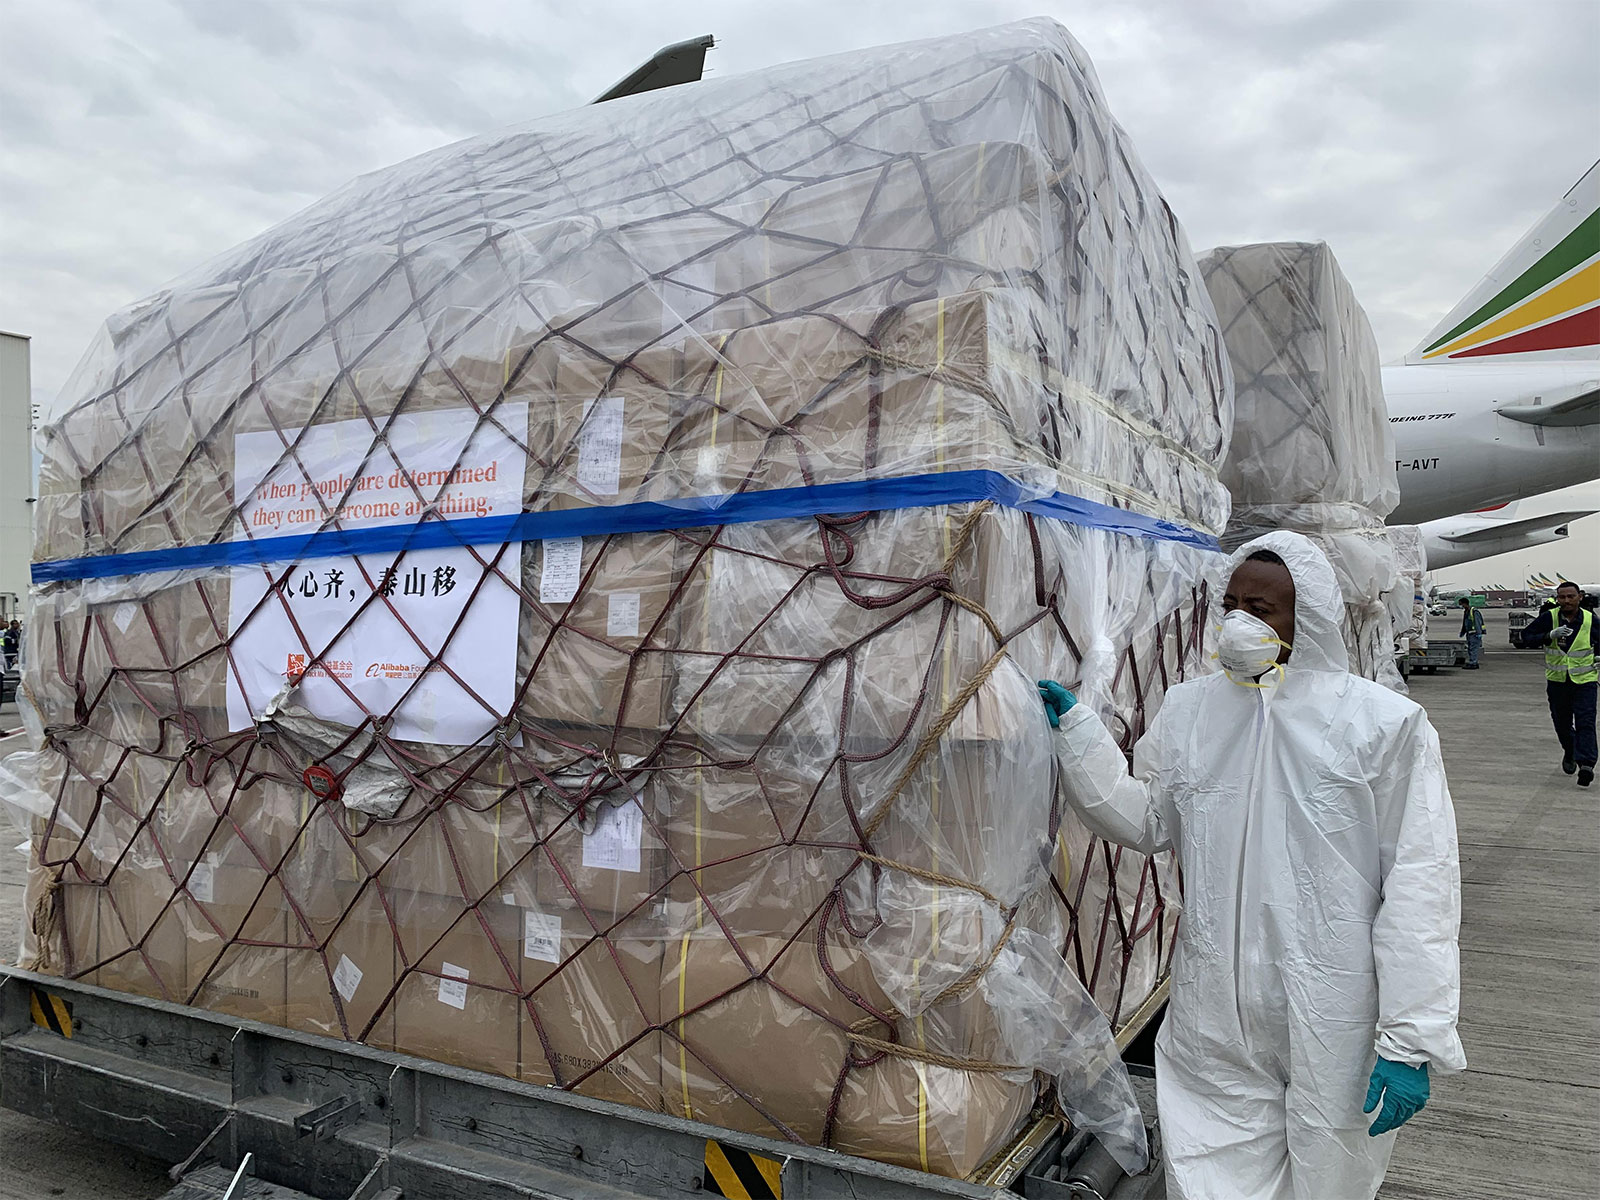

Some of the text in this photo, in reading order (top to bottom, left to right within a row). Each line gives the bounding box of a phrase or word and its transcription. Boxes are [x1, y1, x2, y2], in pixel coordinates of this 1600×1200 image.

[1388, 412, 1456, 423] OEING 777F
[255, 481, 296, 501] When
[356, 474, 384, 492] are
[388, 461, 497, 489] determined
[253, 506, 285, 530] they
[287, 507, 316, 524] can
[404, 491, 493, 520] athing.
[380, 663, 410, 672] Alibaba
